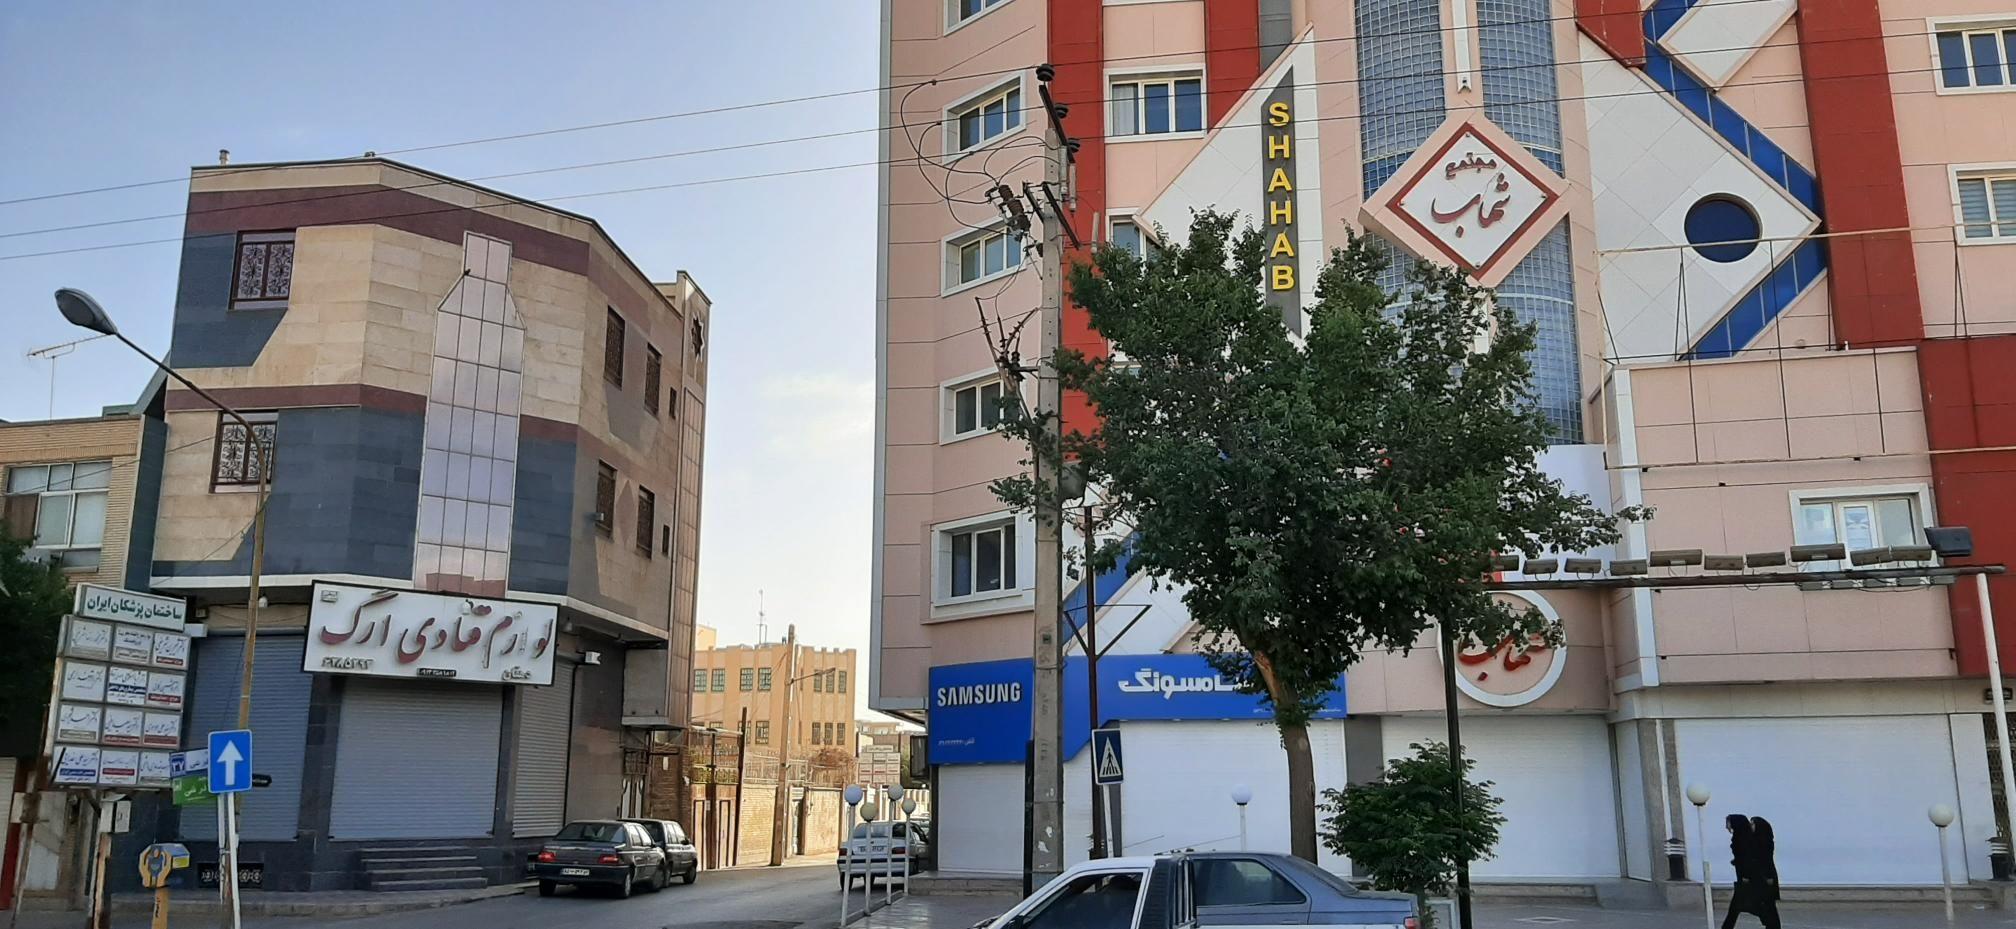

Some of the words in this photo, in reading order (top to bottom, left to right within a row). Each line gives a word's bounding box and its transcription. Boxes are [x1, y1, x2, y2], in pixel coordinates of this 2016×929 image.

[1444, 151, 1498, 180] مجتمع
[1268, 102, 1295, 290] SHAHAB
[1430, 171, 1511, 237] شهاب
[86, 595, 112, 612] ایران
[111, 596, 144, 620] پزشکان
[144, 603, 182, 620] ساختمان
[319, 588, 399, 646] ارگ
[937, 681, 1021, 707] SAMSUNG
